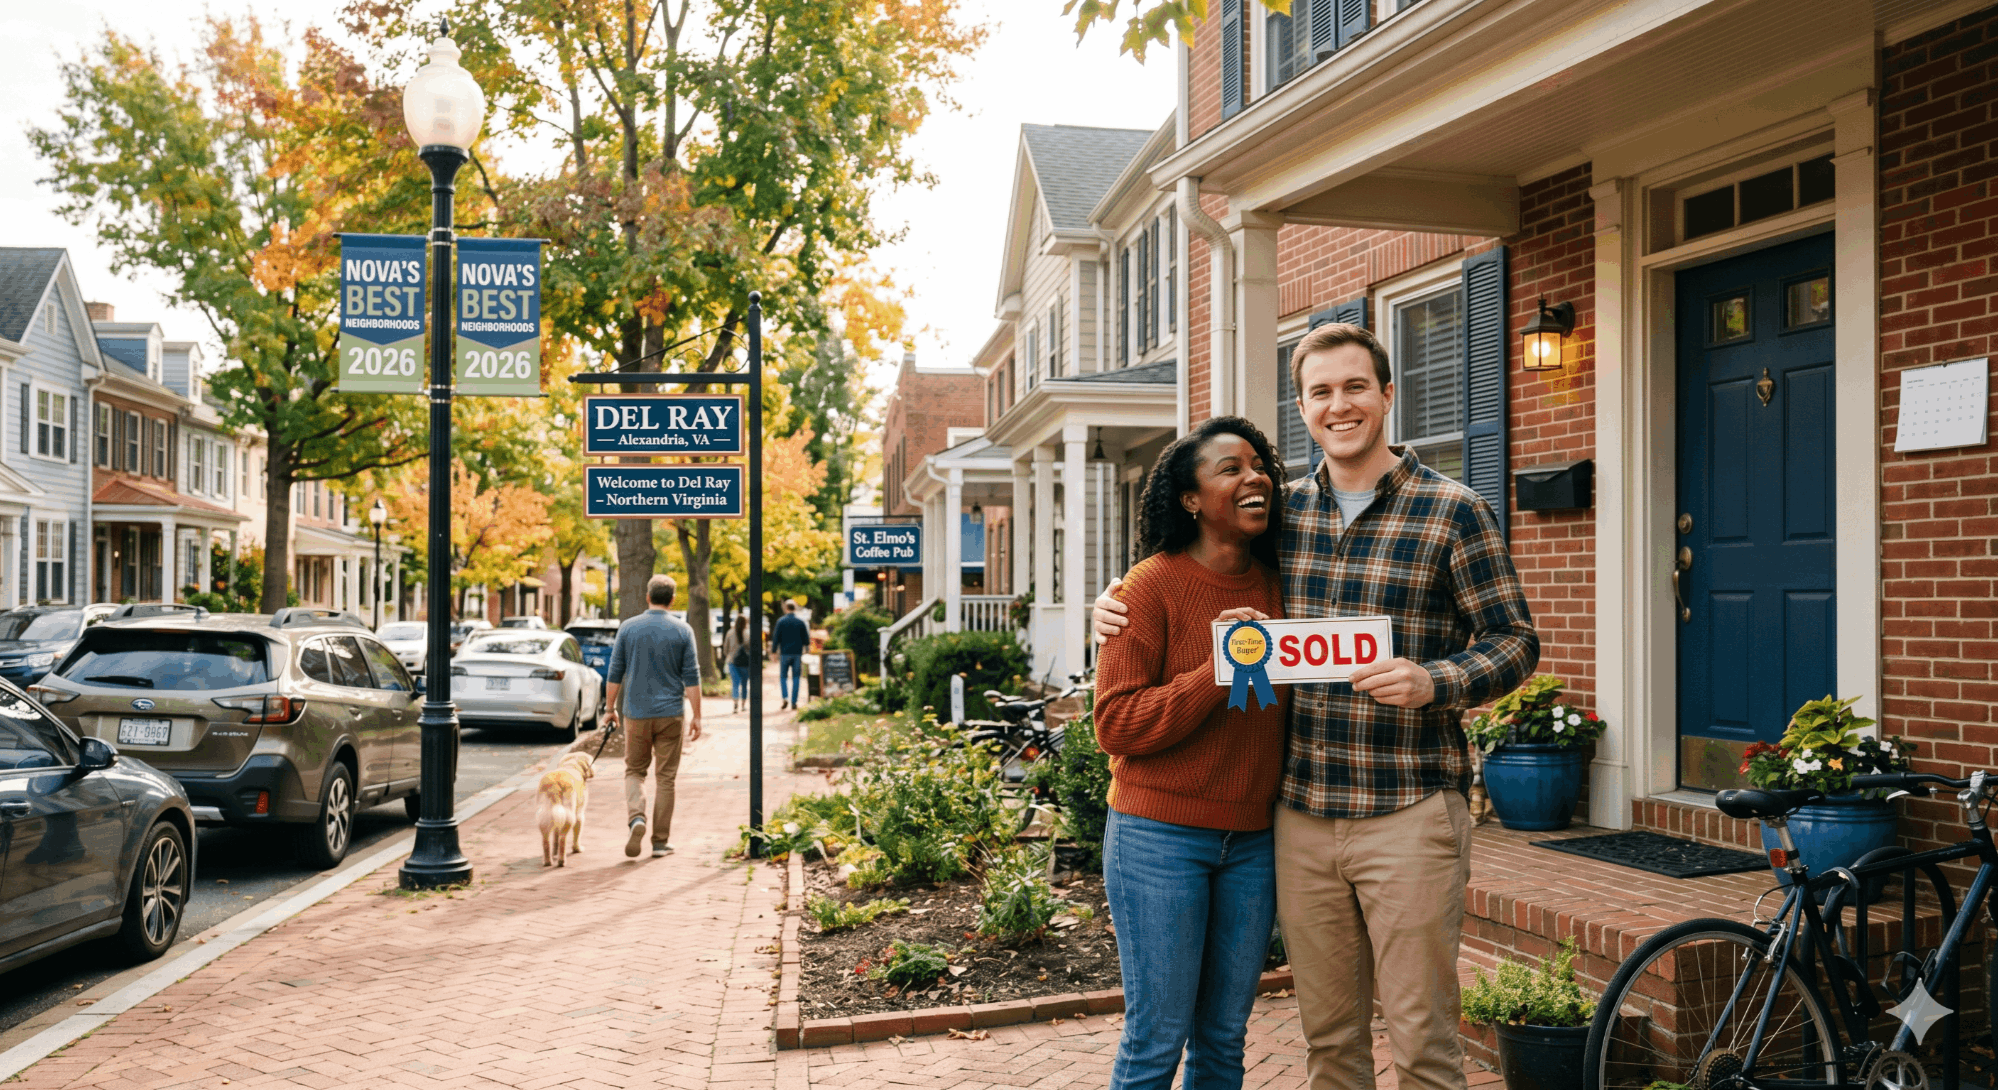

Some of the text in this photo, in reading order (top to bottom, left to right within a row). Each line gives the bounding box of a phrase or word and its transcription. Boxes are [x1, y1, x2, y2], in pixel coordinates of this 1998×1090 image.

[346, 259, 421, 284] NOVA'S
[462, 263, 535, 287] NOVA'S
[346, 284, 420, 317] BEST
[462, 288, 535, 320] BEST
[345, 318, 420, 330] NEIGHBORHOODS
[461, 321, 535, 333] NEIGHBORHOODS
[347, 346, 416, 377] 2026
[464, 350, 532, 379] 2026
[594, 405, 733, 430] DEL RAY
[617, 433, 711, 447] Alexandria, VA
[596, 475, 732, 493] Welcome to Del Ray
[606, 492, 669, 506] Northern
[671, 493, 728, 510] Virginia
[853, 530, 916, 545] St. Elmo's
[855, 546, 914, 558] Coffee Pub
[1279, 633, 1378, 667] SOLD
